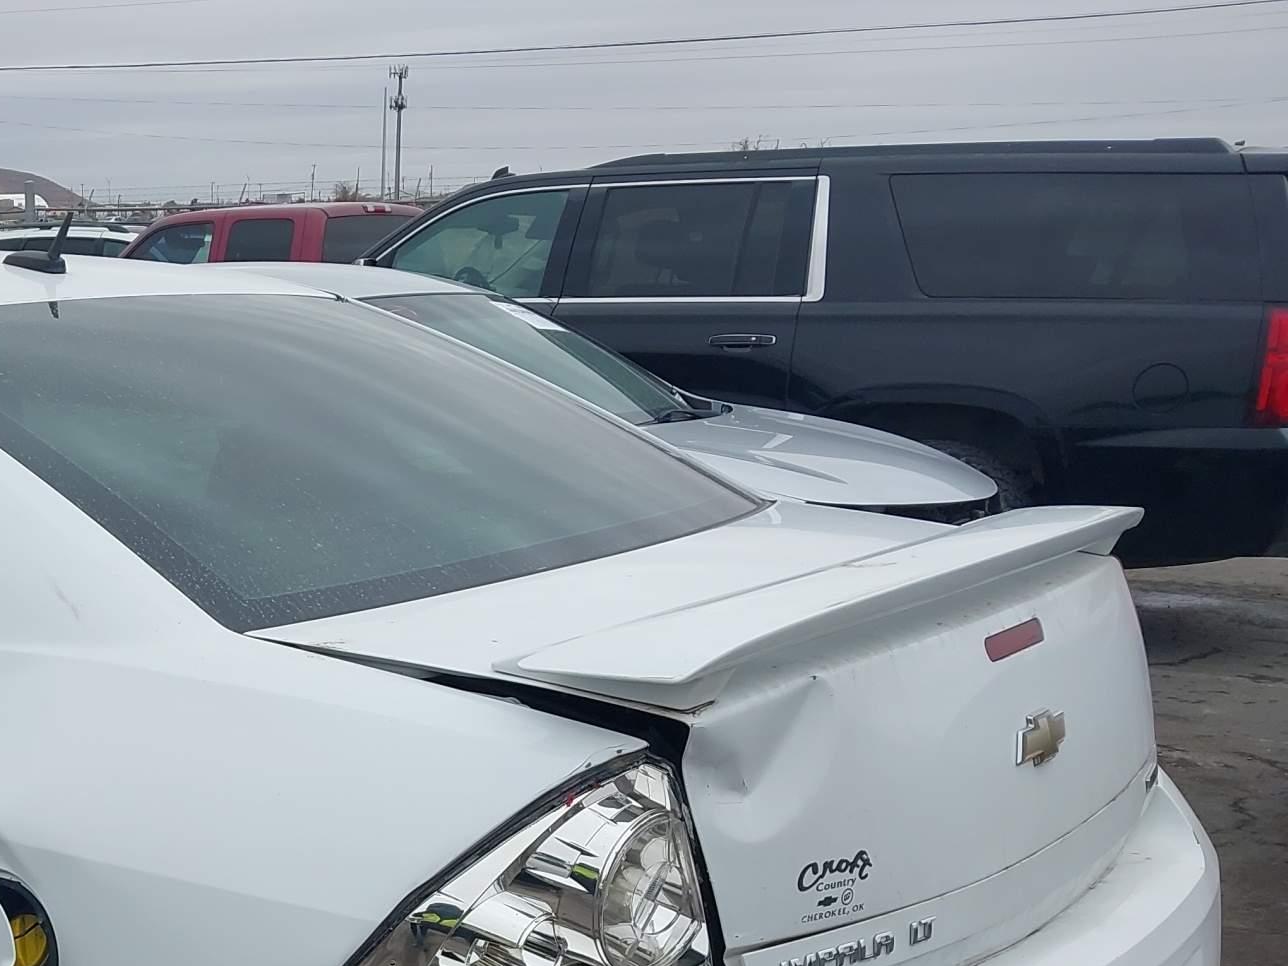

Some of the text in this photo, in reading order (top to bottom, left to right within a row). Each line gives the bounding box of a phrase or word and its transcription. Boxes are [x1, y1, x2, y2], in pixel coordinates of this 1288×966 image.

[797, 849, 873, 892] Croft
[816, 877, 857, 892] Country
[801, 902, 865, 924] CHEROKEE, OK
[909, 915, 937, 946] LT
